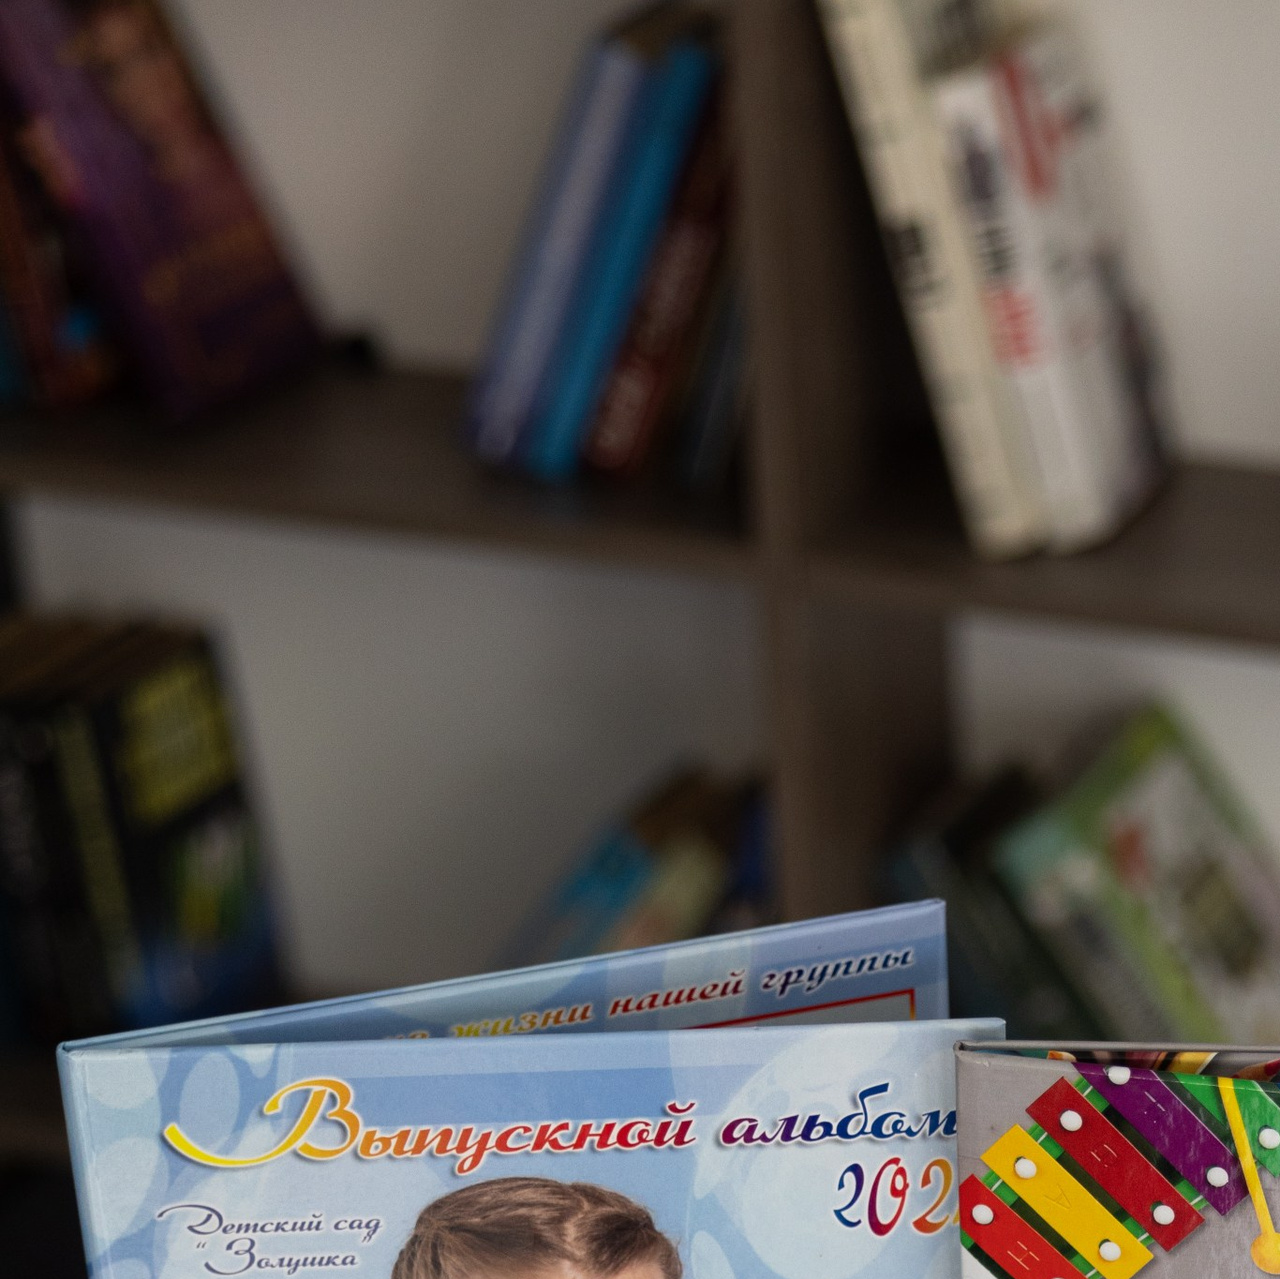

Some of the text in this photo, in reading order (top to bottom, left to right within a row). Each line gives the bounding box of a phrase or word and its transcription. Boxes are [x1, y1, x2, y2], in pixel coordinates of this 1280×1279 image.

[450, 949, 914, 1038] жизни нашей группы
[163, 1077, 957, 1174] Выпускной альбом
[157, 1204, 382, 1236] Детский сад
[833, 1157, 959, 1236] 202
